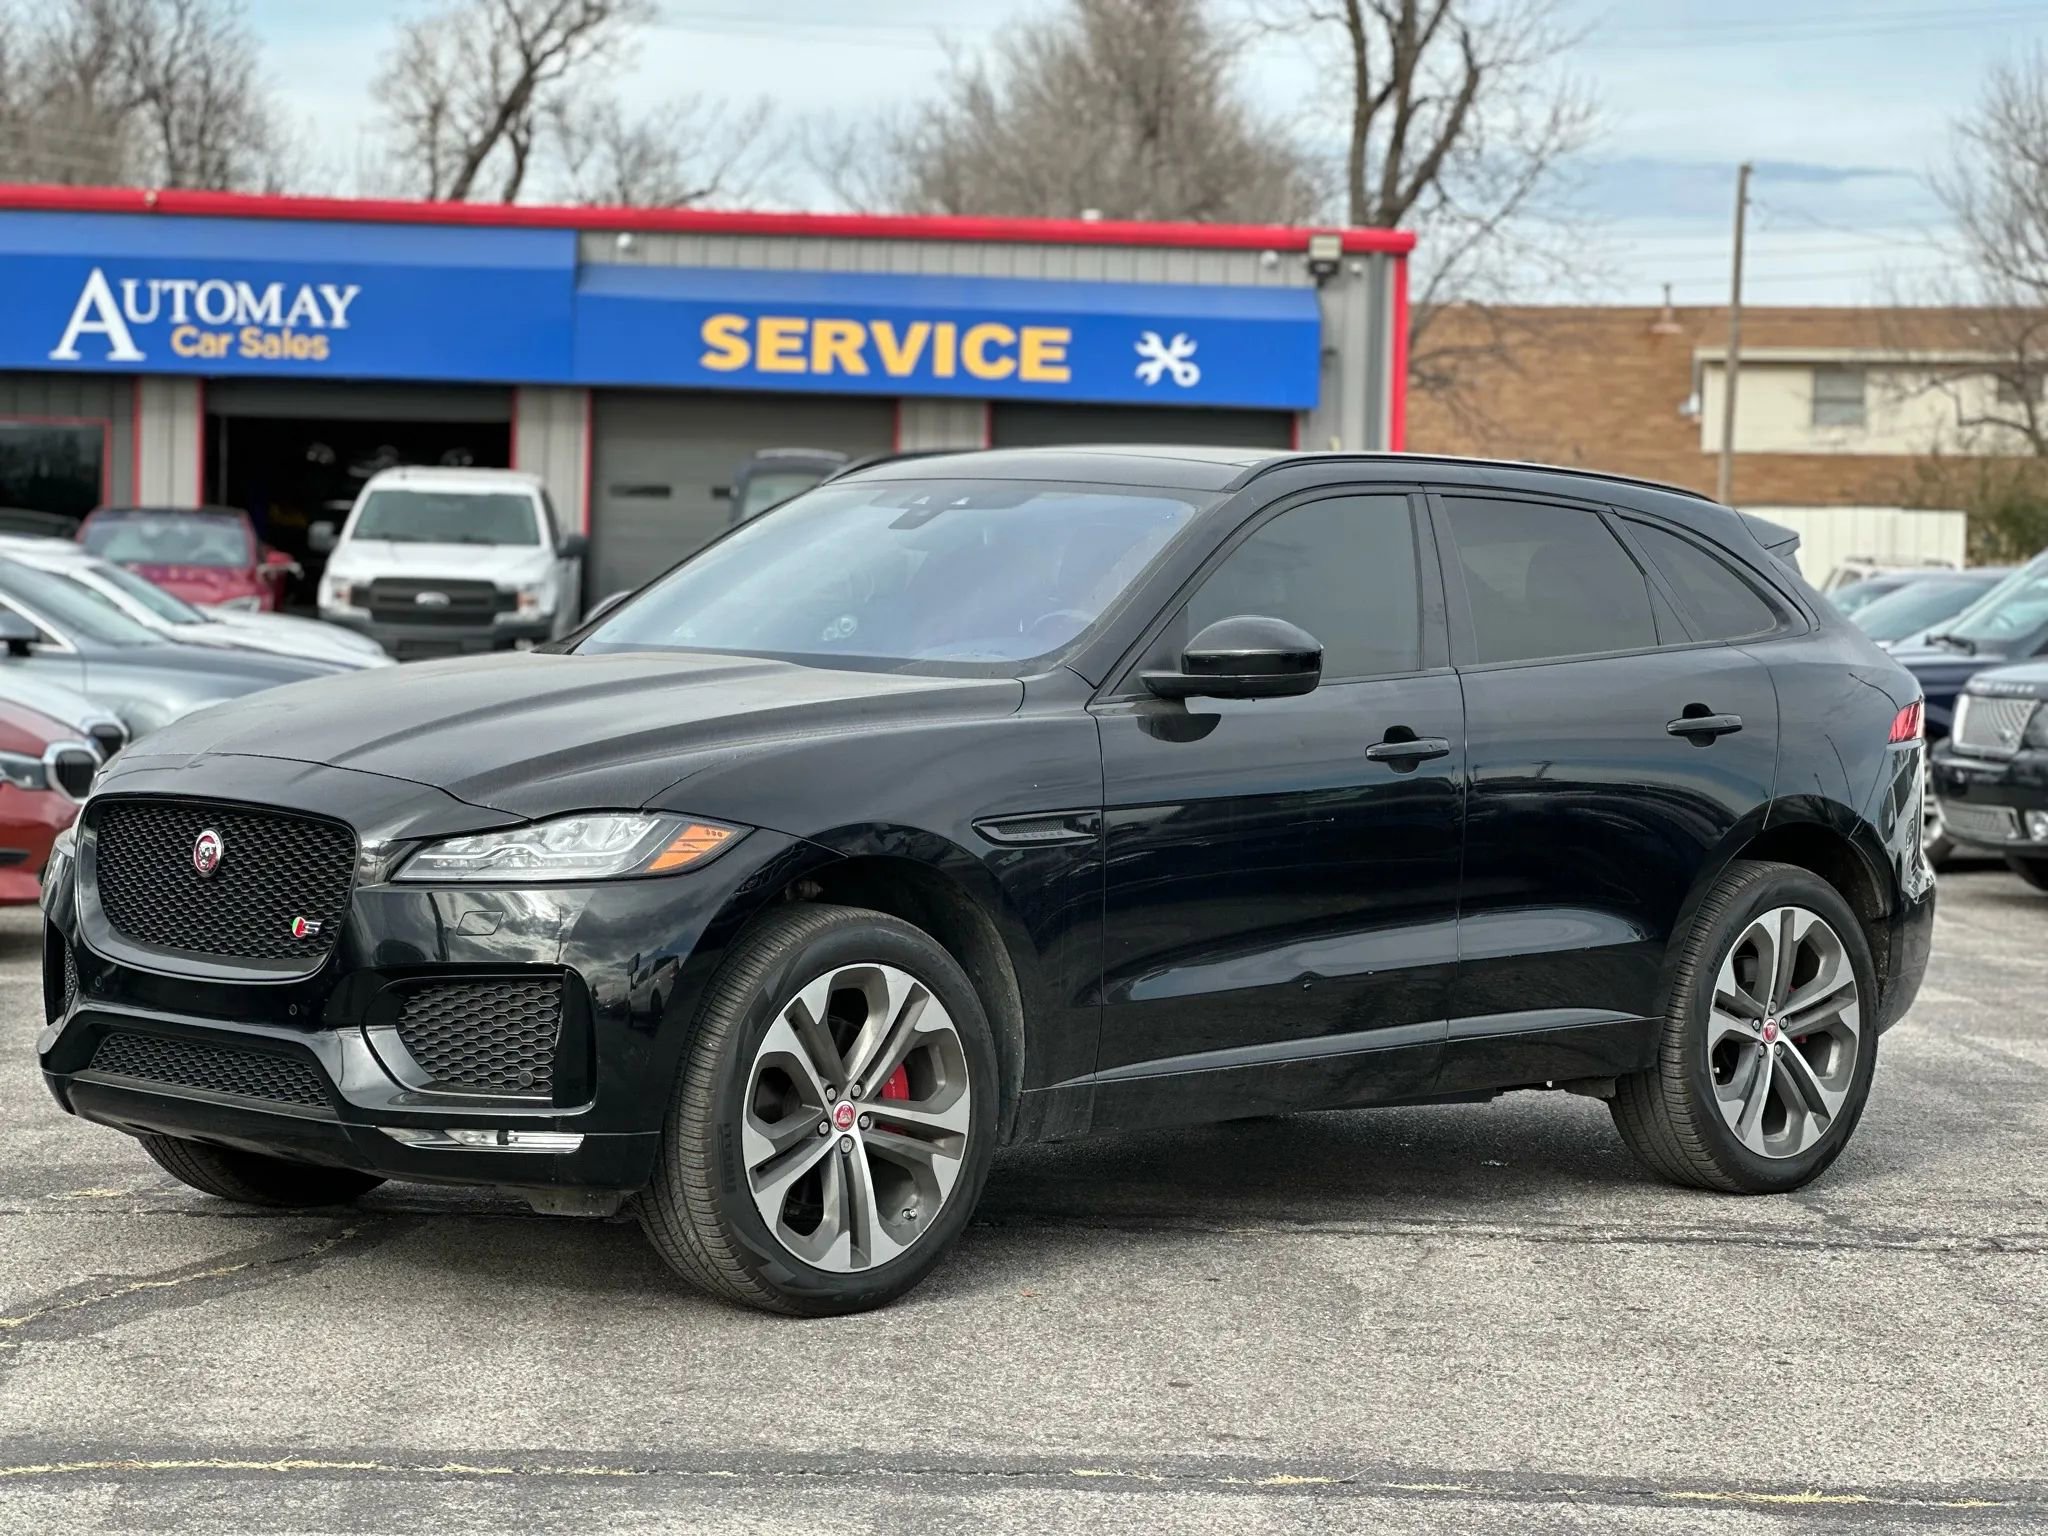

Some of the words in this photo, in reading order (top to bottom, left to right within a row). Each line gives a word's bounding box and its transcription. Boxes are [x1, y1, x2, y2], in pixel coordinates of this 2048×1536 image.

[173, 326, 233, 358] Car
[239, 326, 330, 361] Sales
[700, 313, 1072, 383] SERVICE
